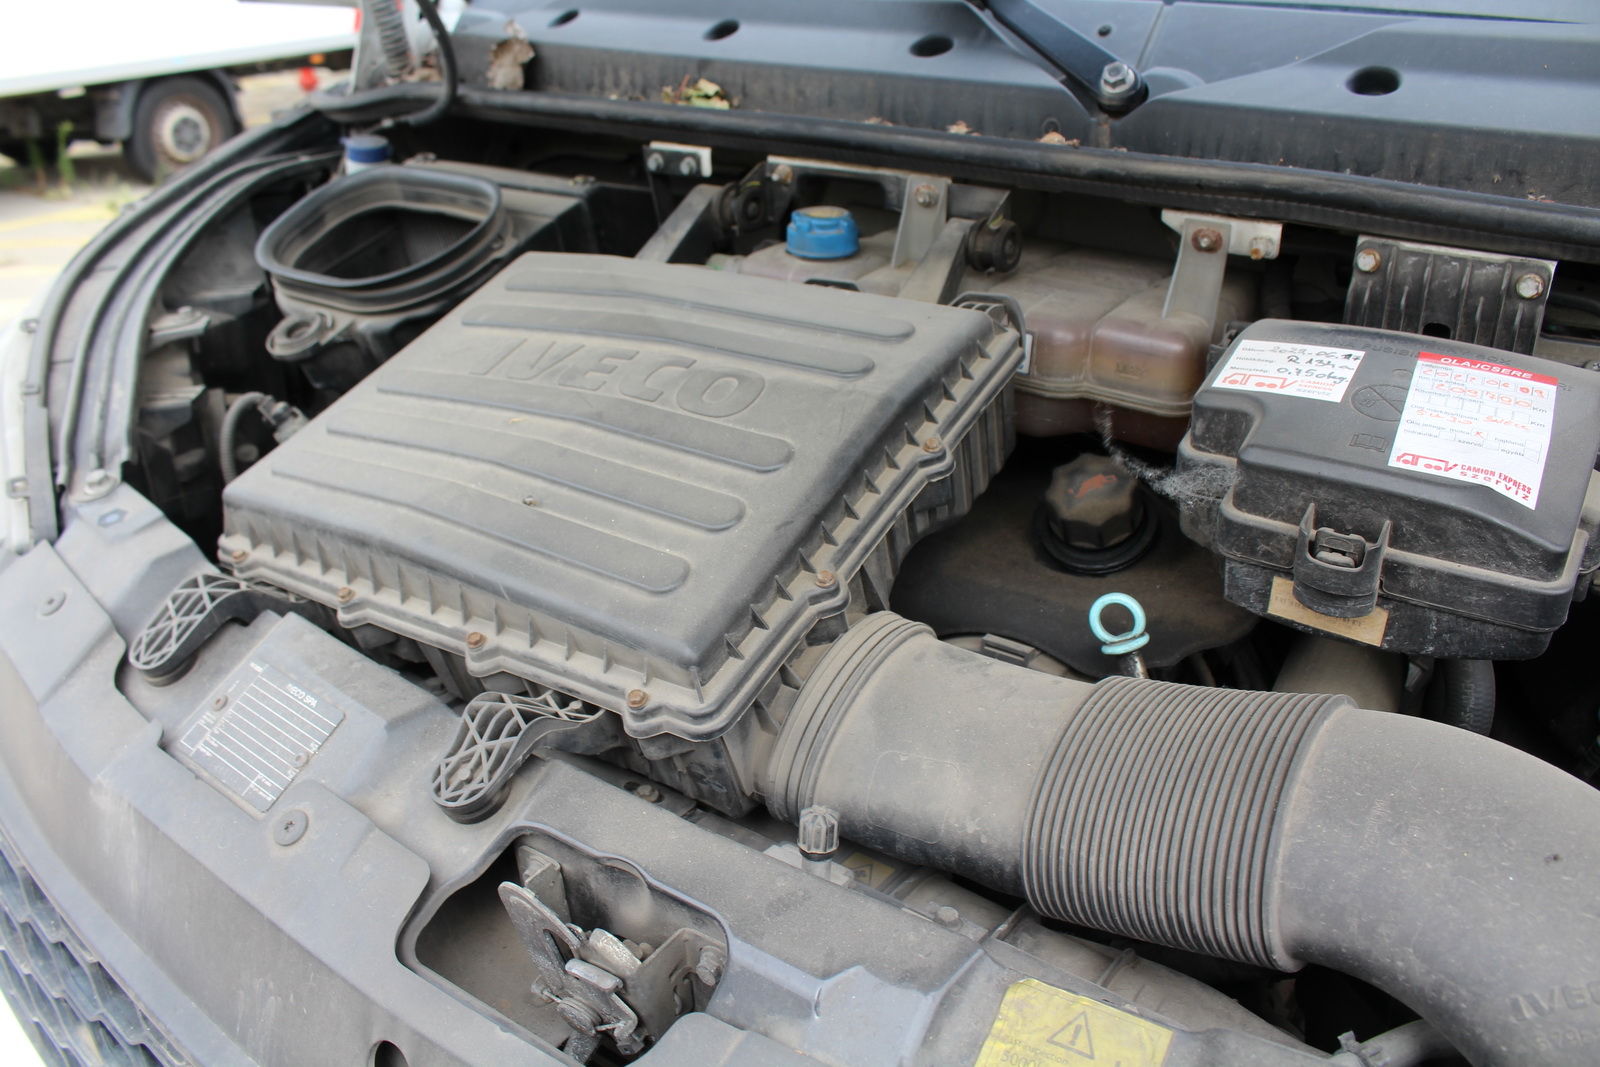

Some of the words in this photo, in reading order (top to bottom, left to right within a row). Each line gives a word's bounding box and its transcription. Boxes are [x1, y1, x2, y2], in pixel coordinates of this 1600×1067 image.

[468, 337, 766, 419] IVECO
[1440, 357, 1534, 380] OLAJCSERE
[1460, 464, 1496, 478] CAMION
[1499, 472, 1533, 496] EXPRESS
